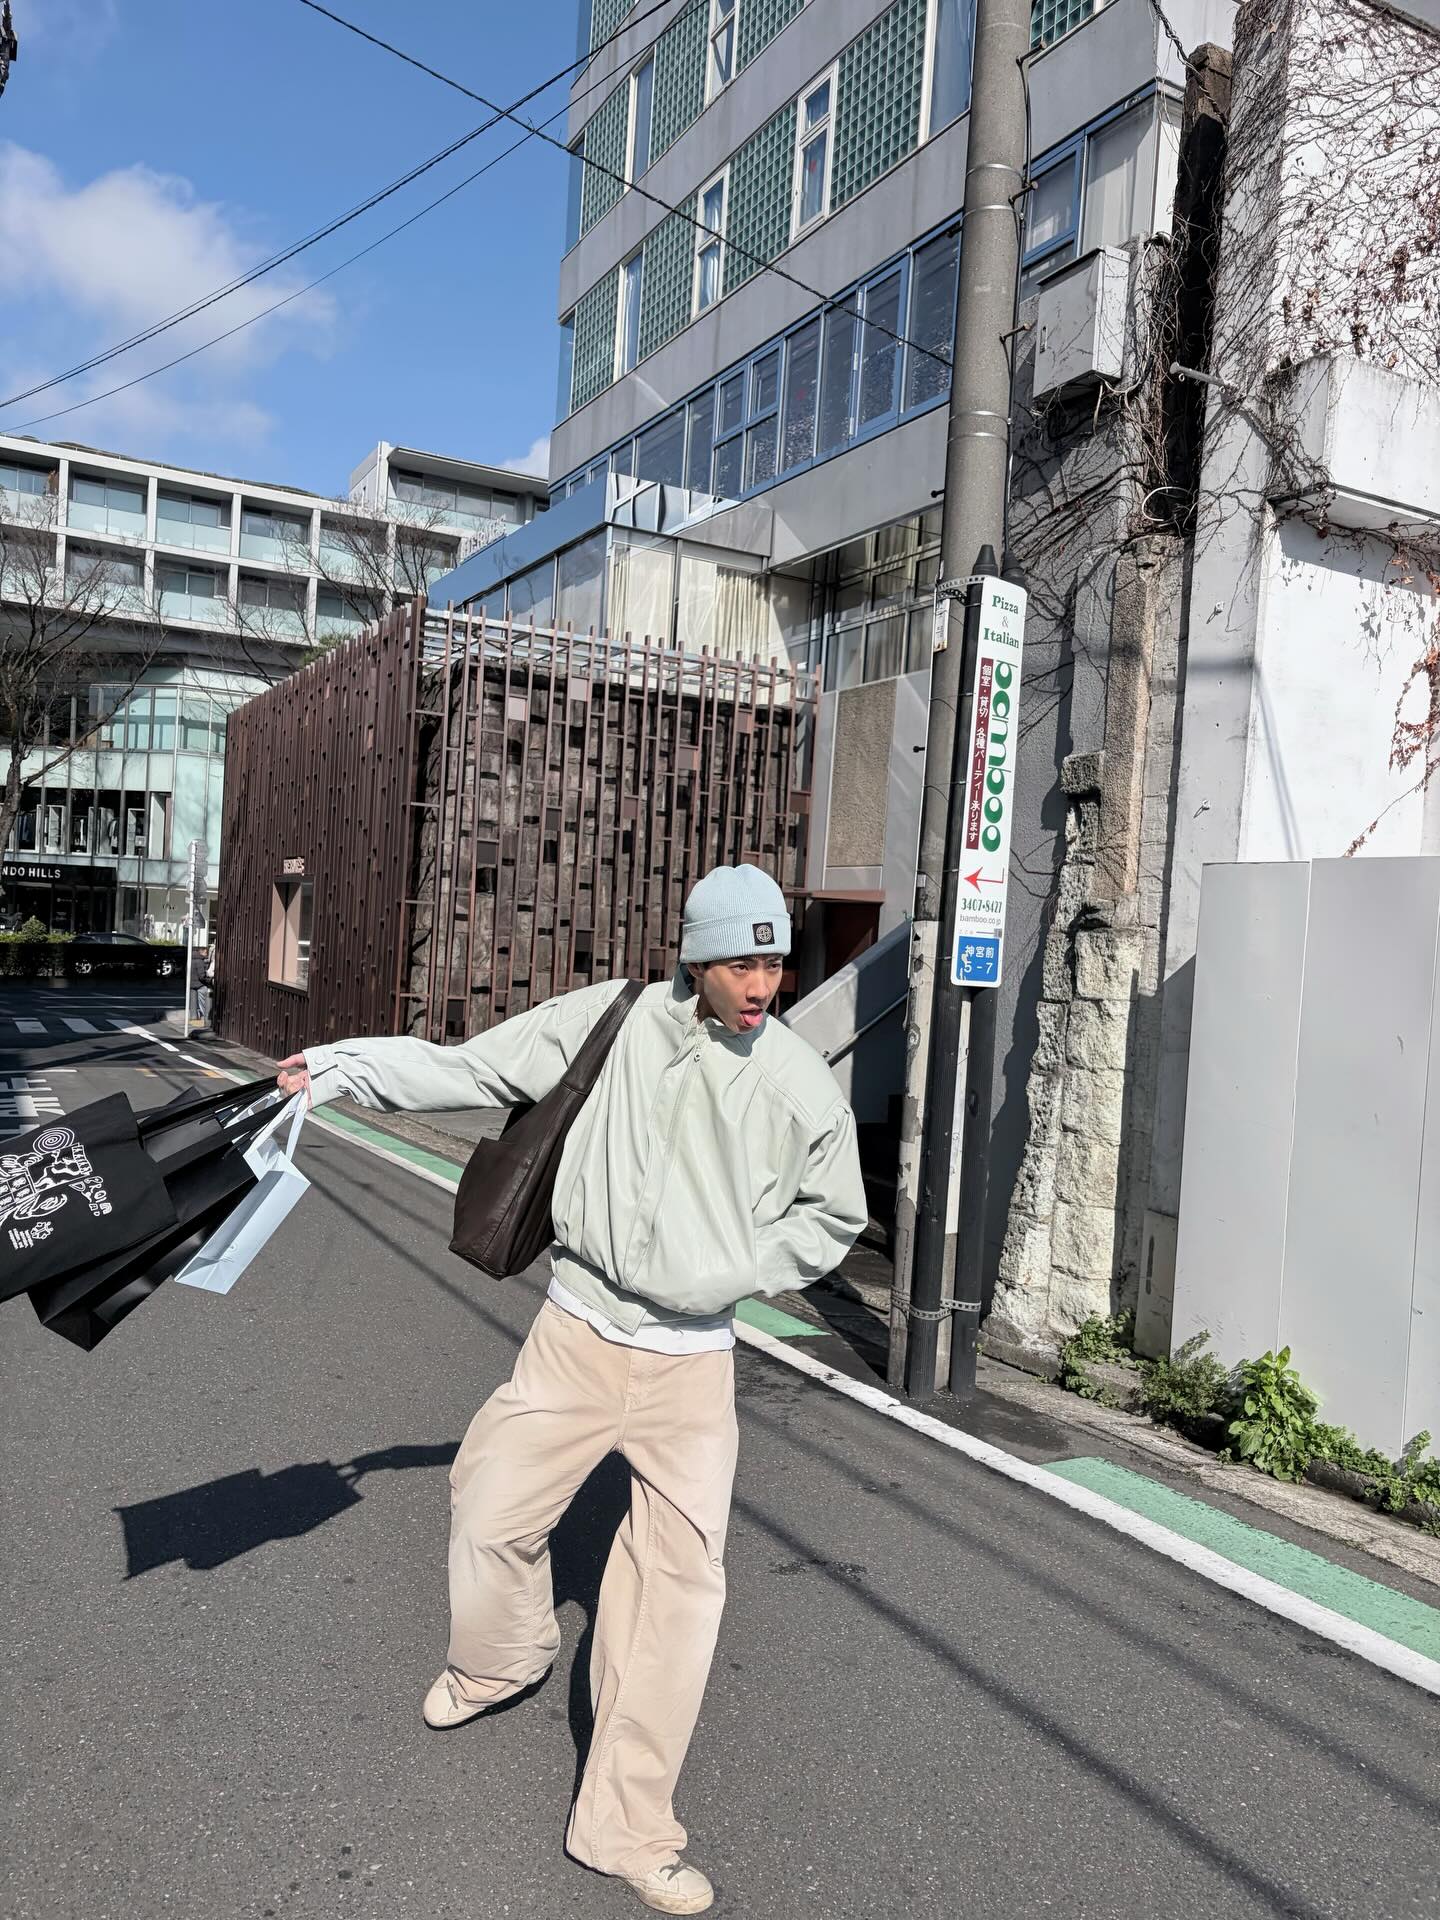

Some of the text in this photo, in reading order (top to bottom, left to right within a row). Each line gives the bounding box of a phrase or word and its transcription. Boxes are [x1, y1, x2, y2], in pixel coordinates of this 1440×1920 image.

[992, 594, 1019, 615] Pizza
[1001, 615, 1009, 628] &
[983, 627, 1019, 649] Italian
[981, 660, 1018, 853] bamboo
[28, 867, 61, 878] HILLS
[965, 945, 995, 959] 神宮前
